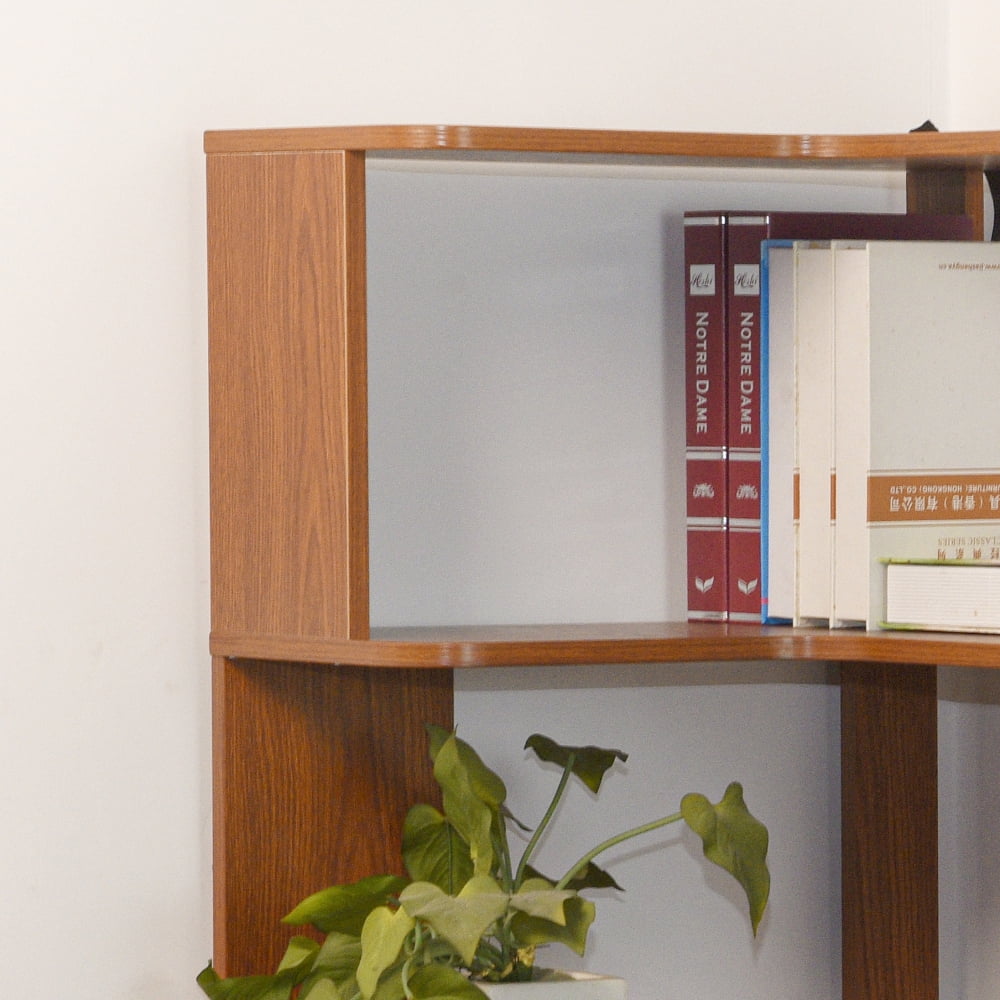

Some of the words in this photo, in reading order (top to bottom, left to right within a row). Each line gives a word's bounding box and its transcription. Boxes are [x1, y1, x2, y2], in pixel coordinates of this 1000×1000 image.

[696, 312, 709, 376] NOTRE
[740, 312, 754, 376] NOTRE
[696, 380, 710, 434] DAME
[740, 380, 754, 435] DAME
